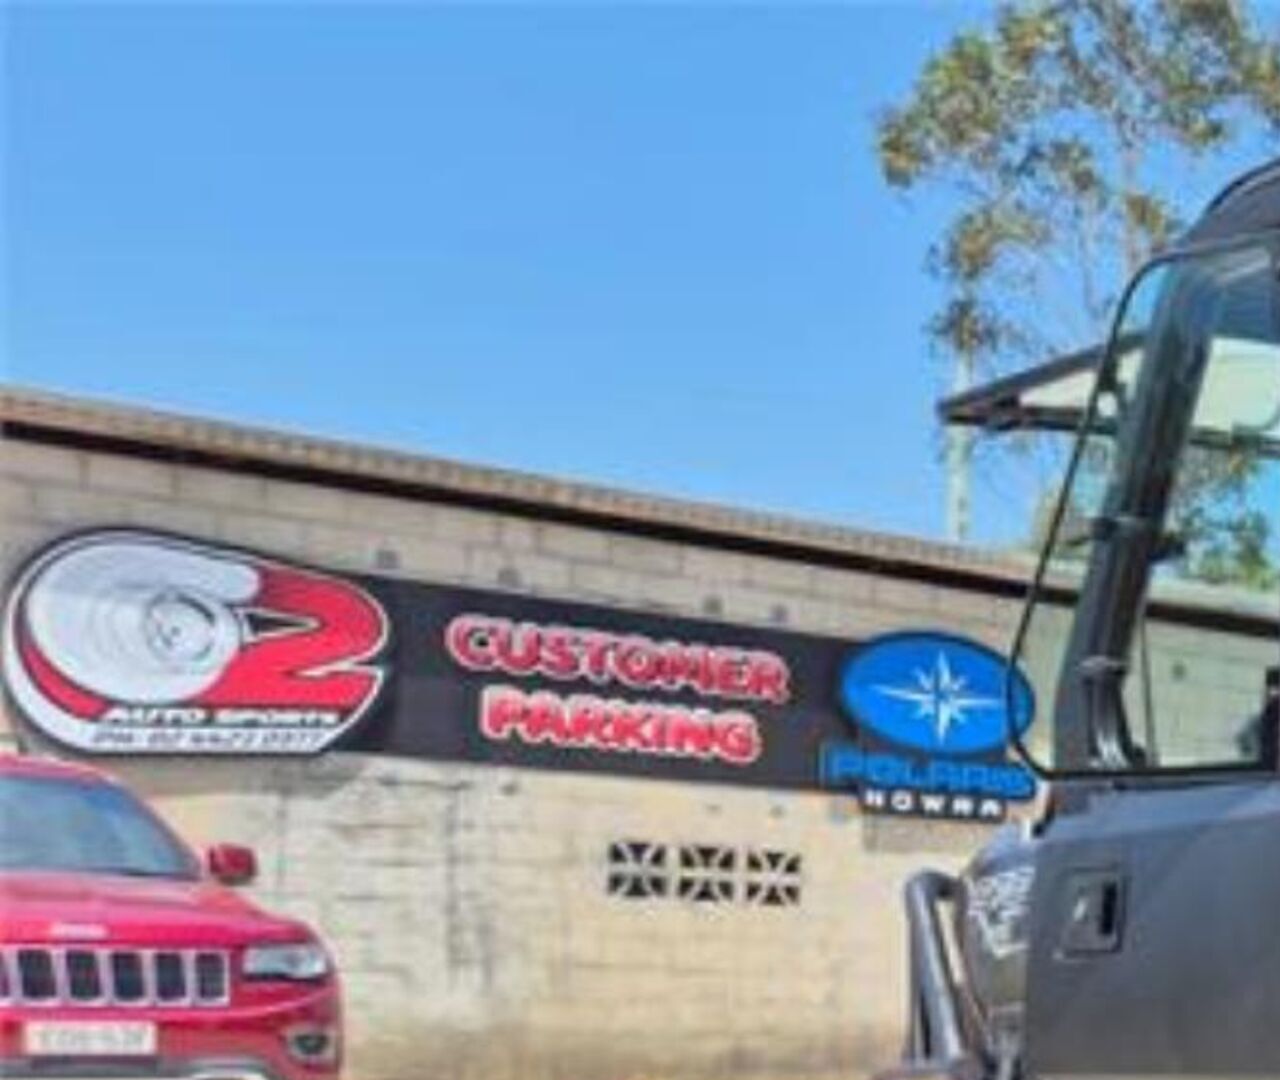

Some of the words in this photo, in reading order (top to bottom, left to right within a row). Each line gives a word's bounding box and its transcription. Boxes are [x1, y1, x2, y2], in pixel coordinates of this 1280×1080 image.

[445, 614, 791, 703] CUSTOMER
[101, 707, 207, 726] AUTO
[212, 709, 342, 727] SPORTS
[479, 684, 761, 763] PARKING
[820, 742, 1037, 802] POLARIS
[863, 788, 1003, 818] NOWRA
